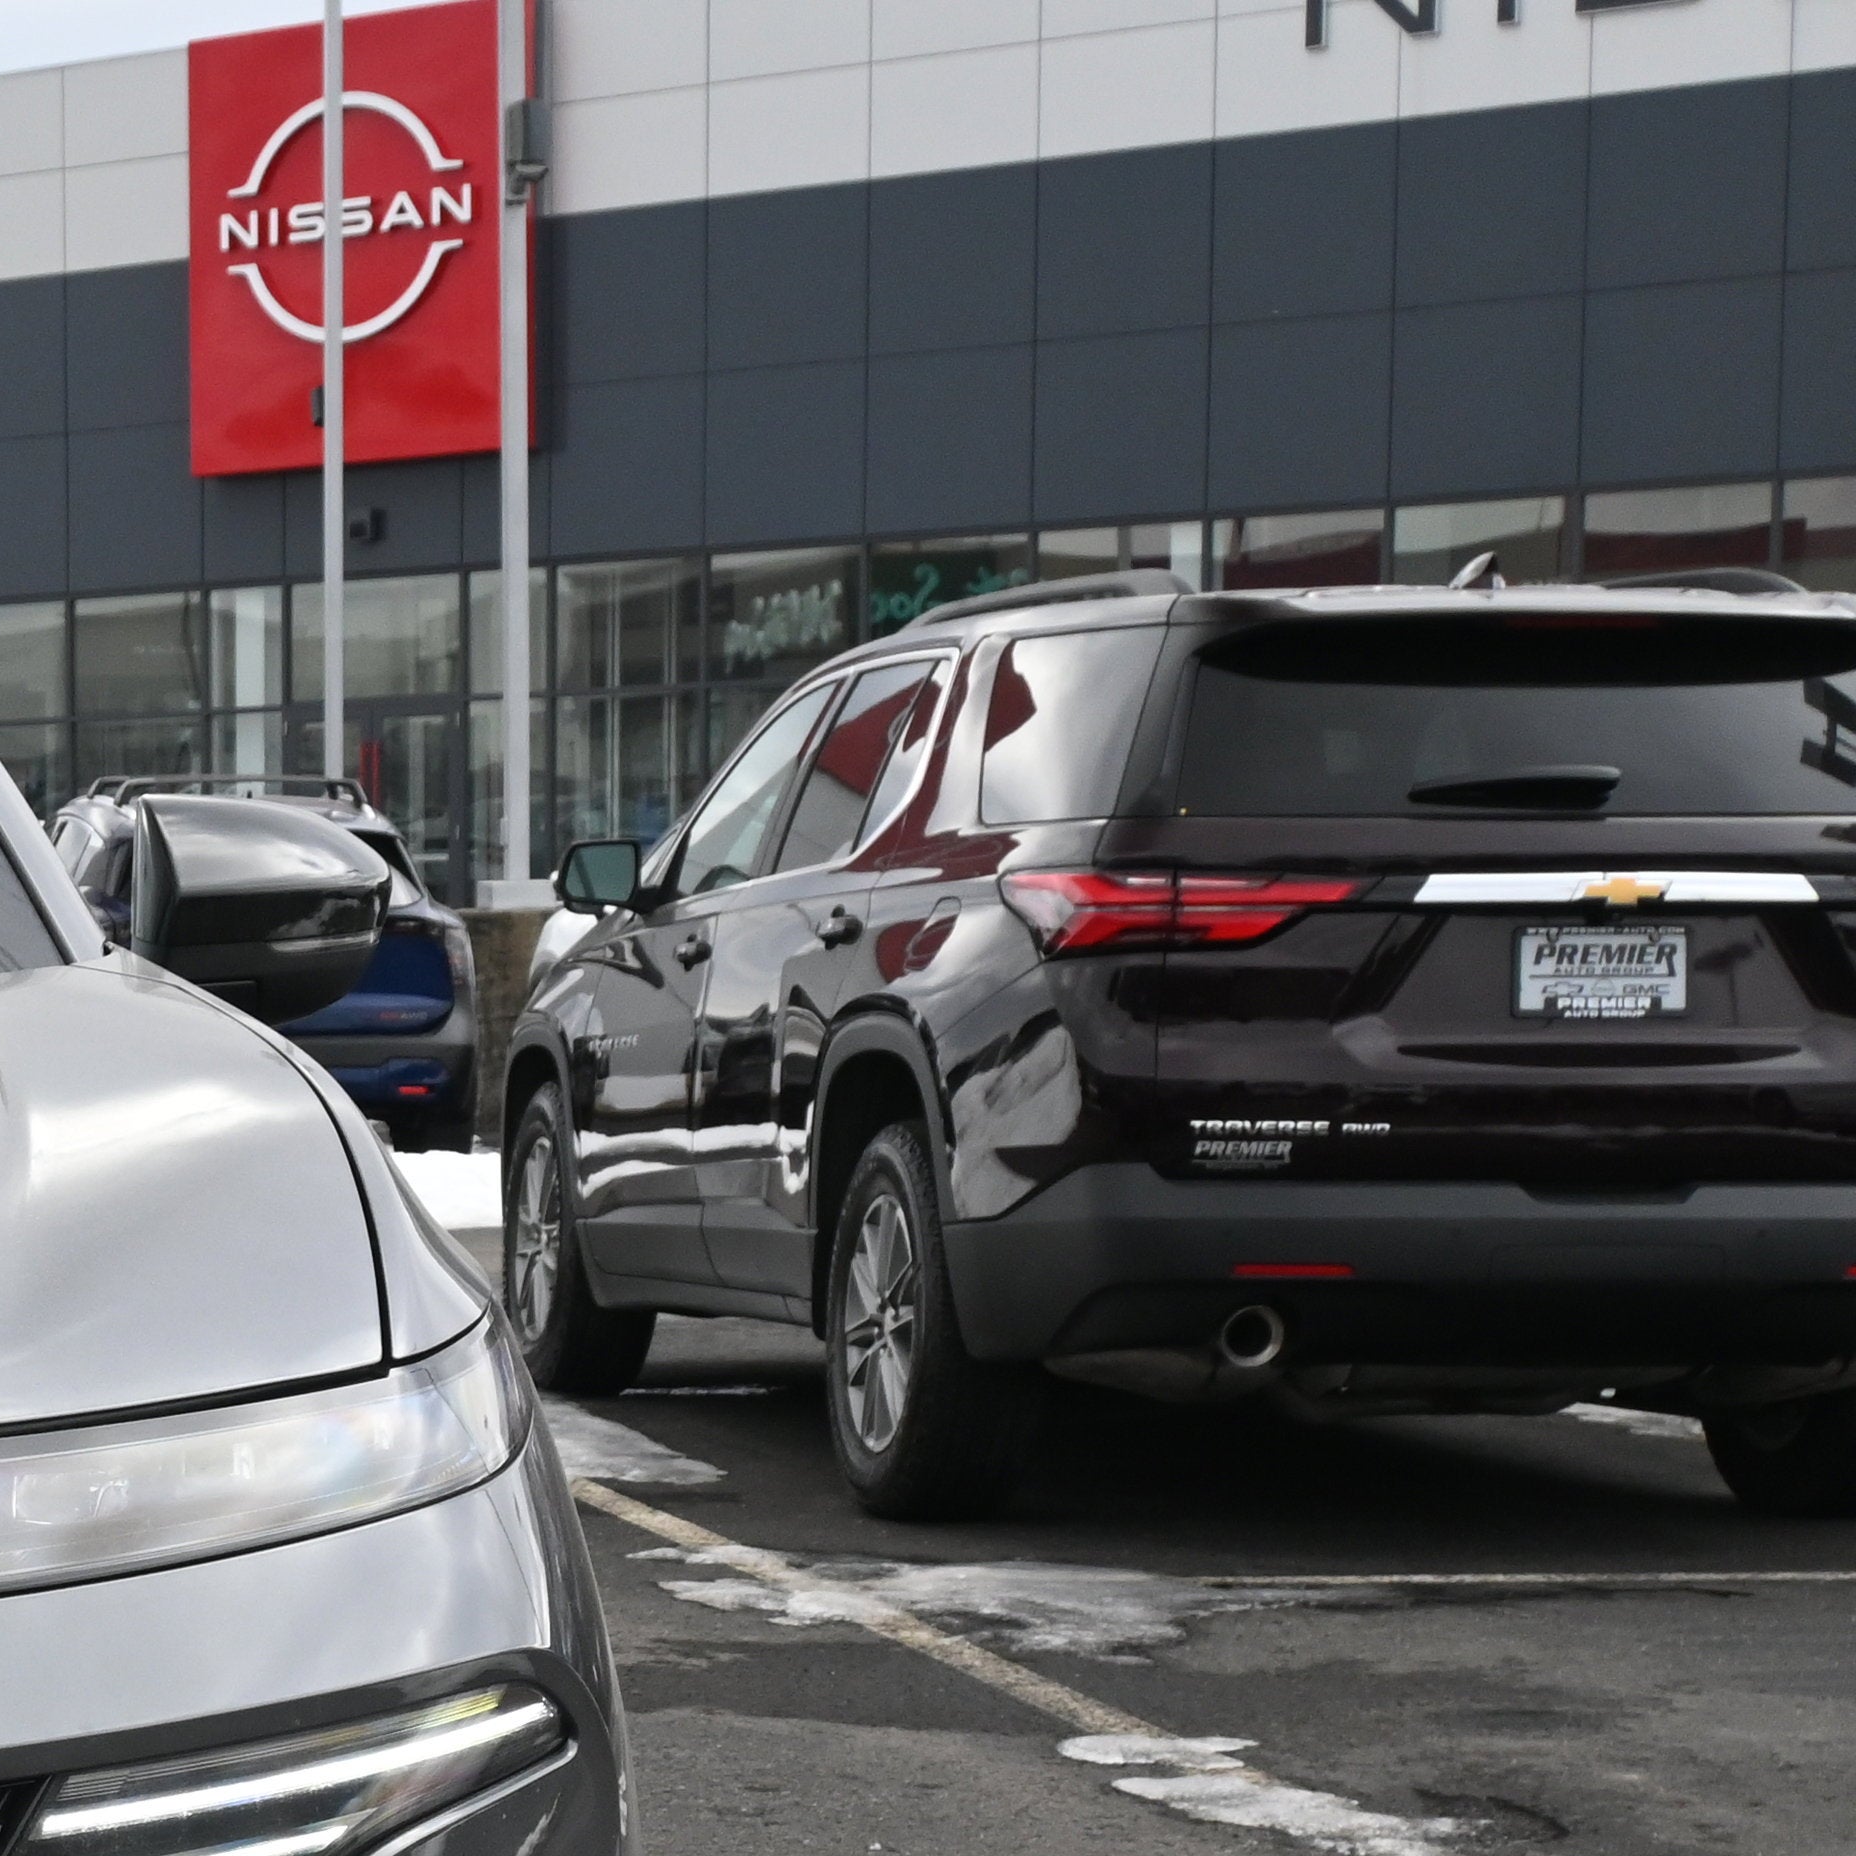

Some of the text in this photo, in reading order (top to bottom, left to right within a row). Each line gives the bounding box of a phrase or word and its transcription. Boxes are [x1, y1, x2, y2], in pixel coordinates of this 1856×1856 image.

[219, 183, 473, 252] NISSAN
[1534, 943, 1677, 977] PREMIER
[1553, 966, 1655, 975] AUTO GROUP
[1623, 983, 1670, 995] GMC
[1557, 997, 1652, 1009] PREMIER
[1563, 1010, 1646, 1018] AUTO GROUP
[1190, 1120, 1391, 1136] TRAVERSE AWD
[1193, 1141, 1292, 1163] PREMIER
